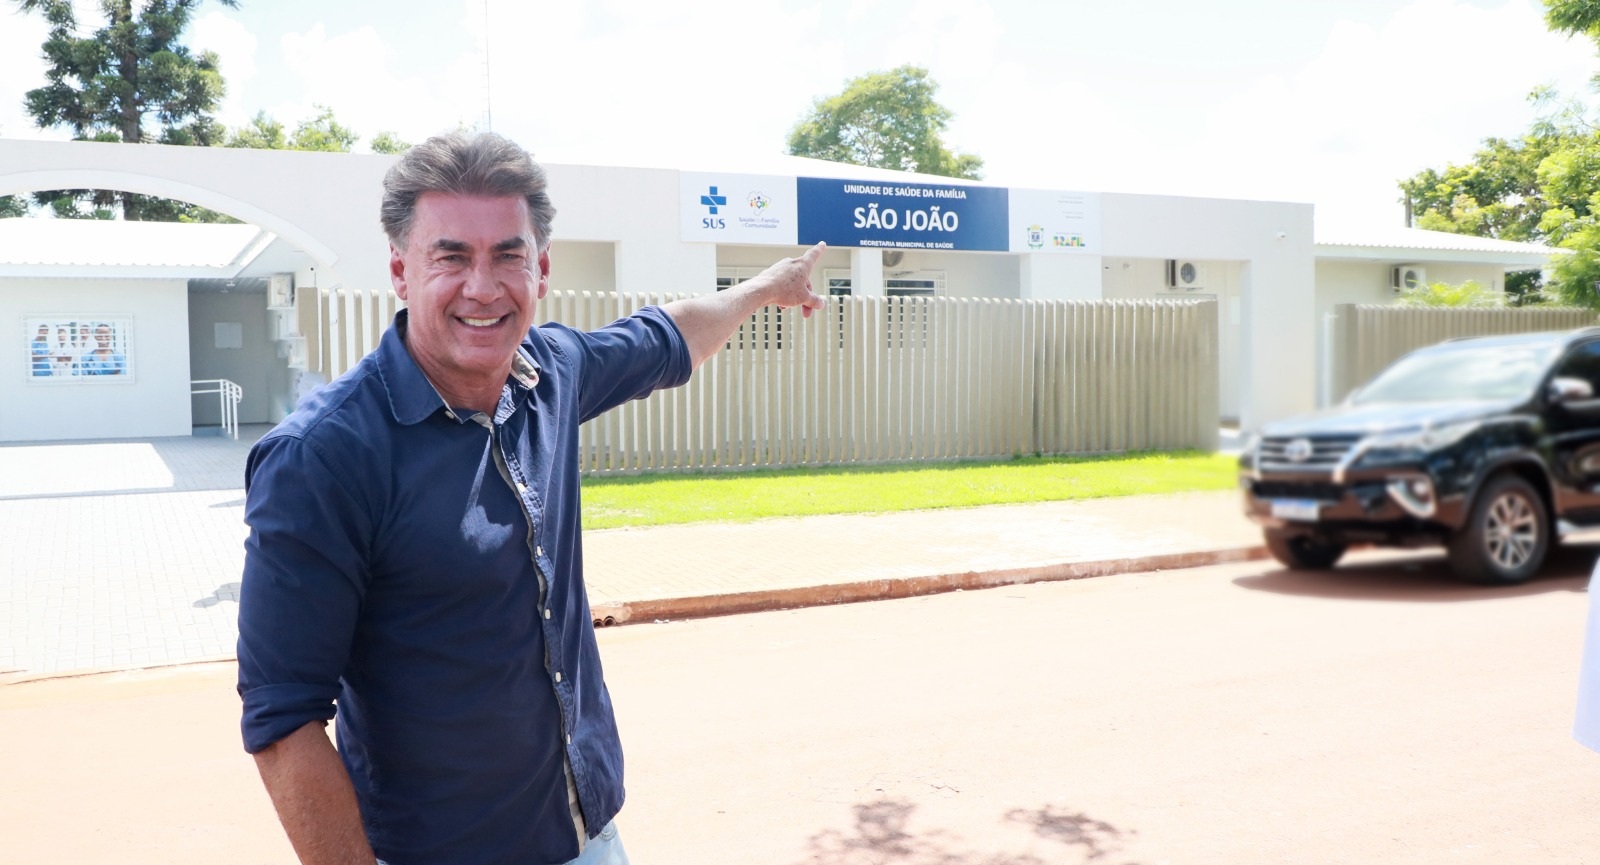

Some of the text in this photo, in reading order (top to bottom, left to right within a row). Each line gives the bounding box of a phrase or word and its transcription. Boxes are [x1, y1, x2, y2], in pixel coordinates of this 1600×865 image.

[844, 184, 967, 199] UNIDADE DE SAÚDE DA FAMÍLIA
[702, 218, 726, 229] SUS
[854, 203, 959, 232] SÃO JOÃO
[860, 240, 895, 248] SECRETARIA
[934, 241, 954, 249] SAÚDE
